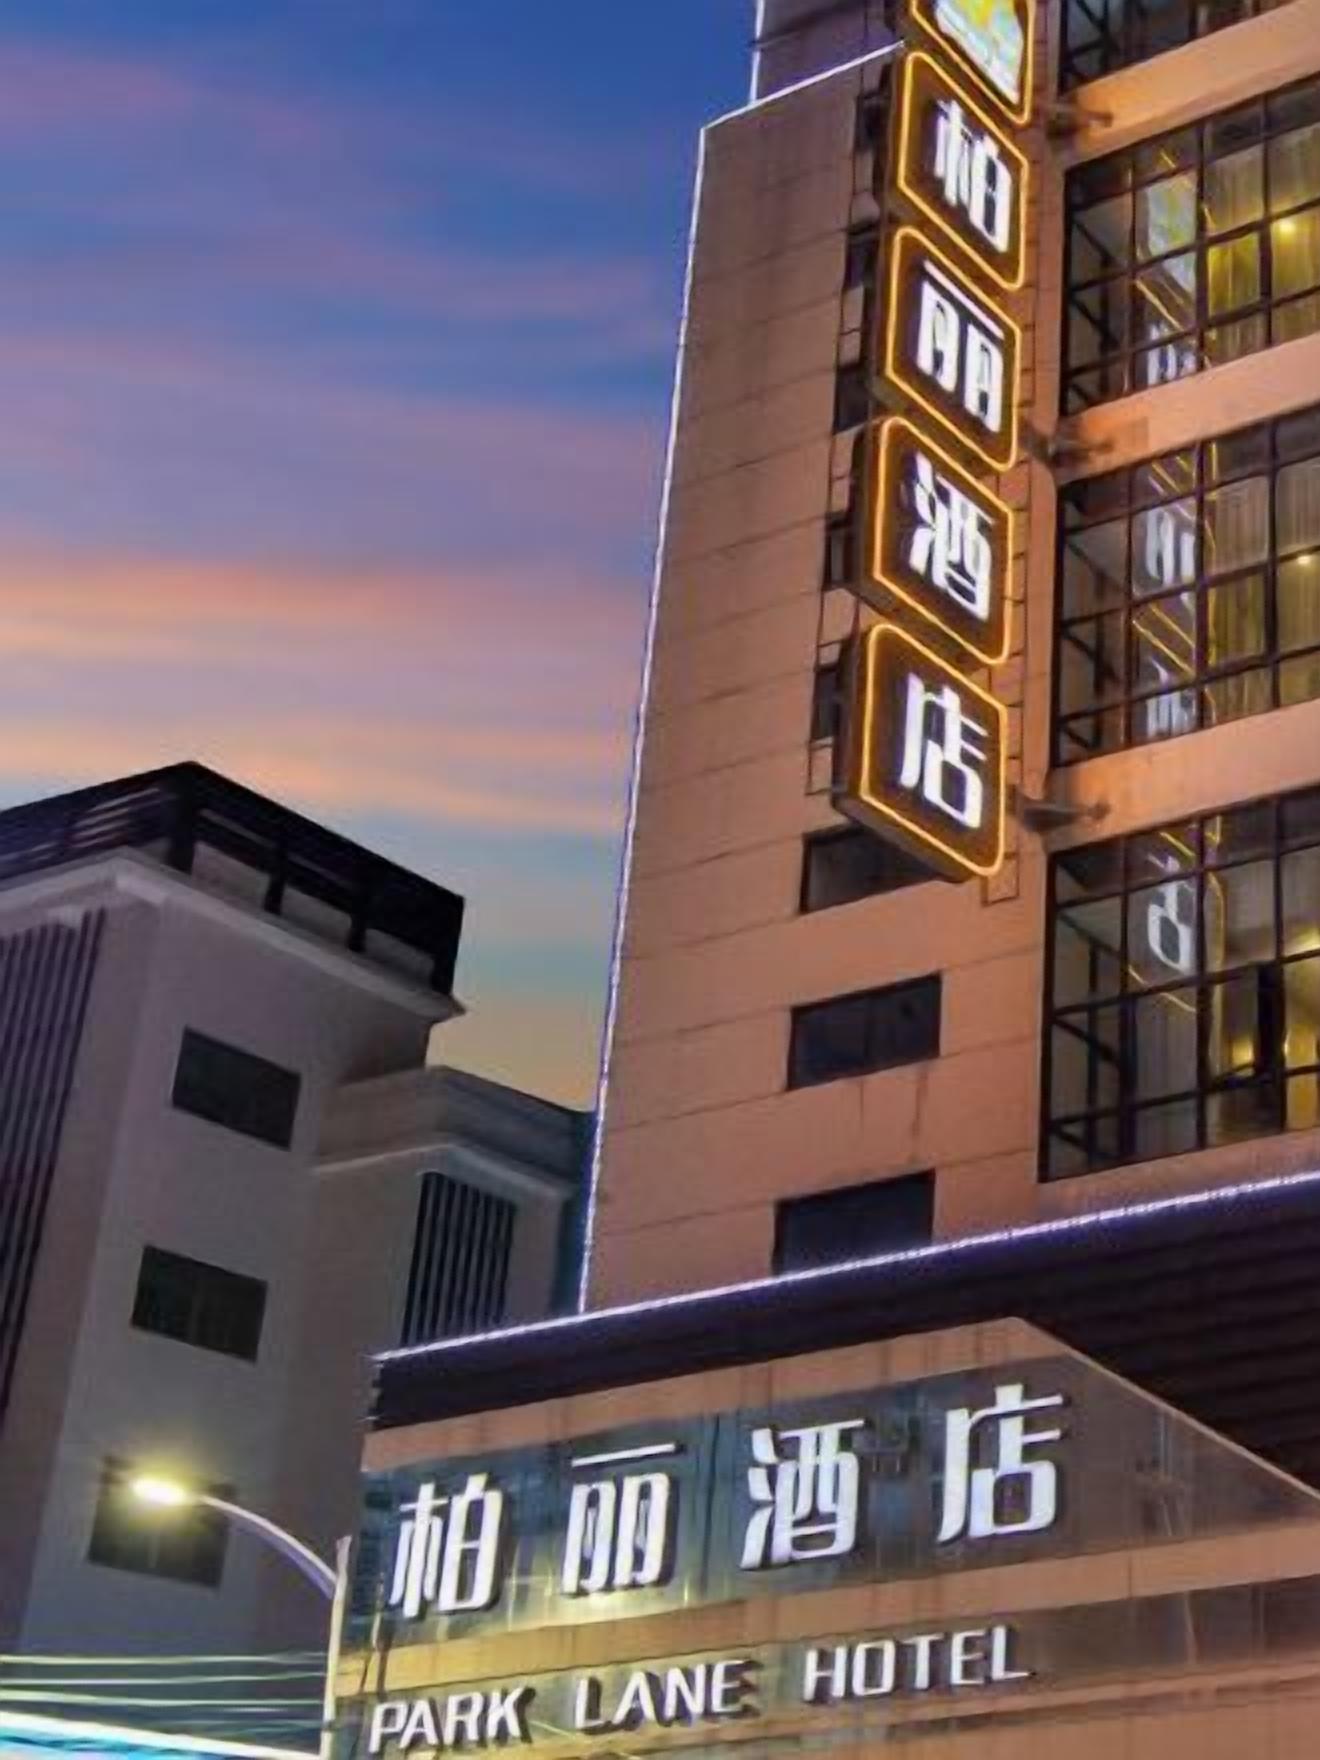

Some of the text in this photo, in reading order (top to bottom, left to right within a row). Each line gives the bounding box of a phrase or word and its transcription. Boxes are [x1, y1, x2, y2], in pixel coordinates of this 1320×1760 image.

[899, 98, 1011, 829] 柏丽酒店
[389, 1384, 1064, 1618] 柏丽酒店
[369, 1625, 1030, 1755] PARK LANE HOTEL
